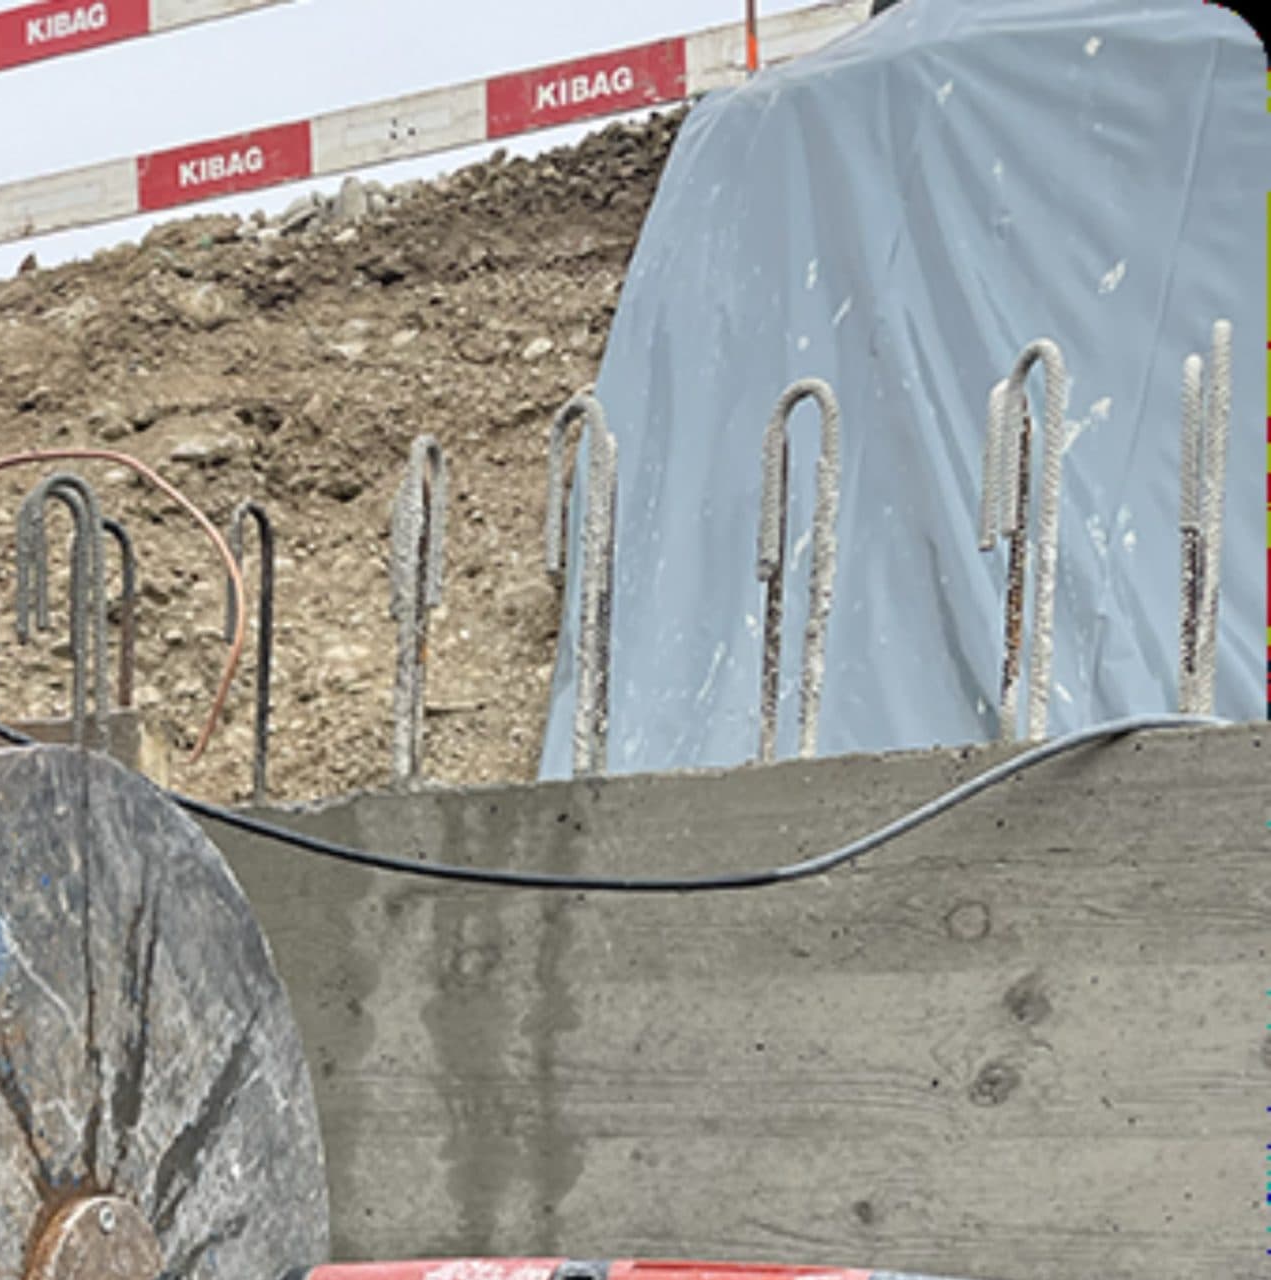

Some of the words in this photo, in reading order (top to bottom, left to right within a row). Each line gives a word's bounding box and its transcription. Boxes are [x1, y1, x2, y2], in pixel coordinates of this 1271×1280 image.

[27, 2, 106, 45] KIBAG
[537, 66, 633, 110] KIBAG
[178, 146, 263, 187] KIBAG
